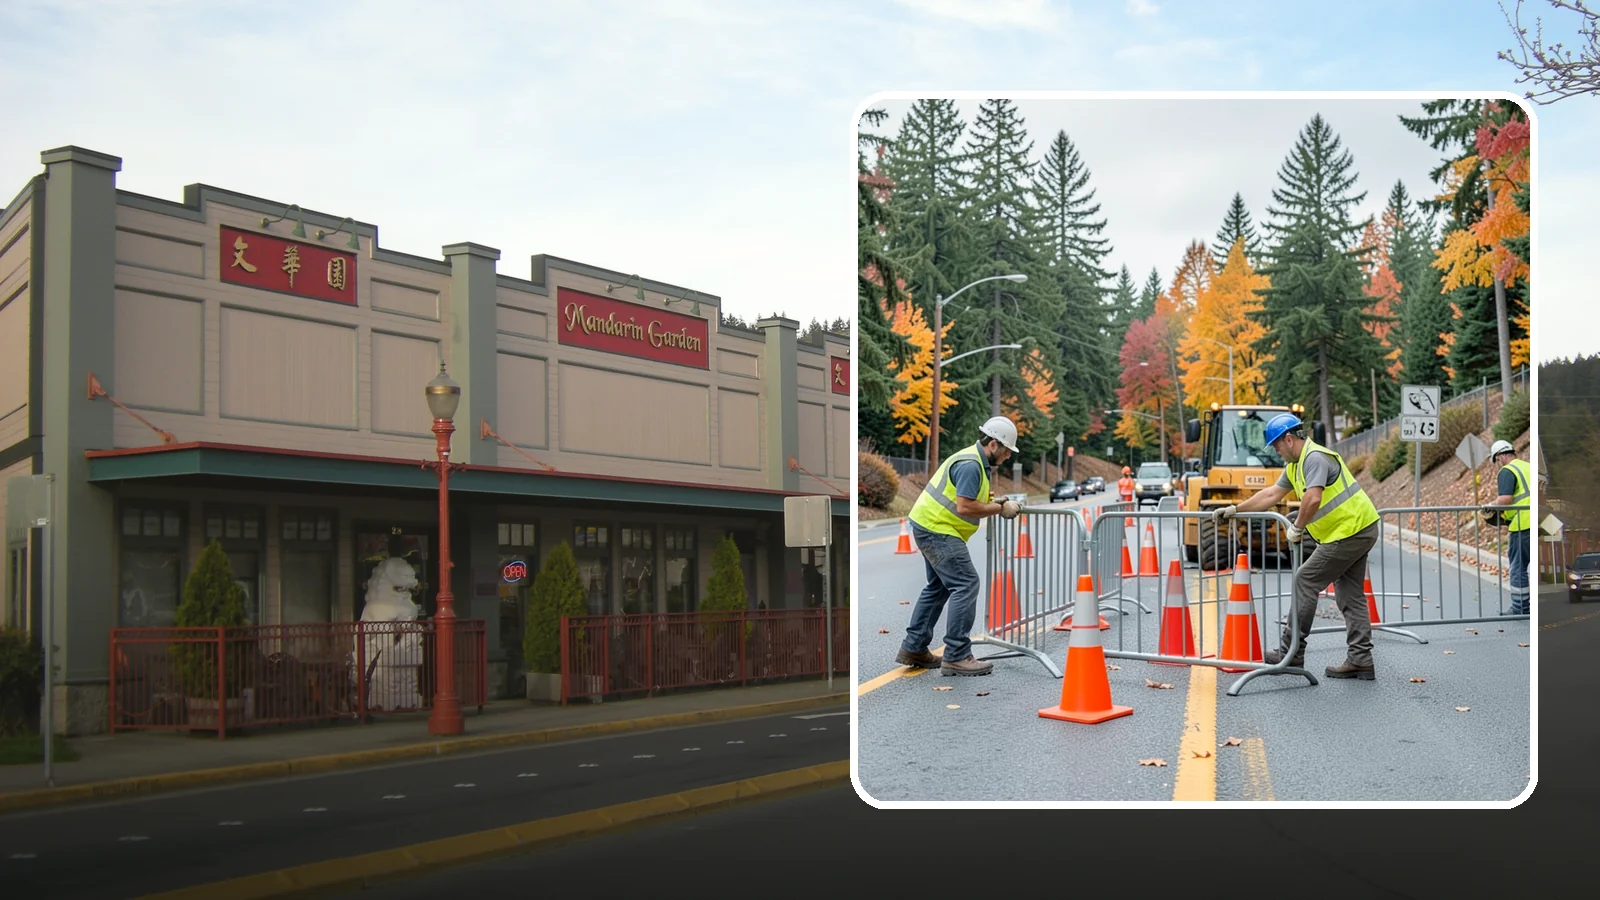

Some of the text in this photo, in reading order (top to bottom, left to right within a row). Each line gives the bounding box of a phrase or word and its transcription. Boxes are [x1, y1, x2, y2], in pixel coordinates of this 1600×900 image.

[231, 235, 346, 291] 文華園
[564, 302, 701, 352] Mandarin Garden
[834, 363, 847, 386] 文
[503, 565, 527, 578] OPEN
